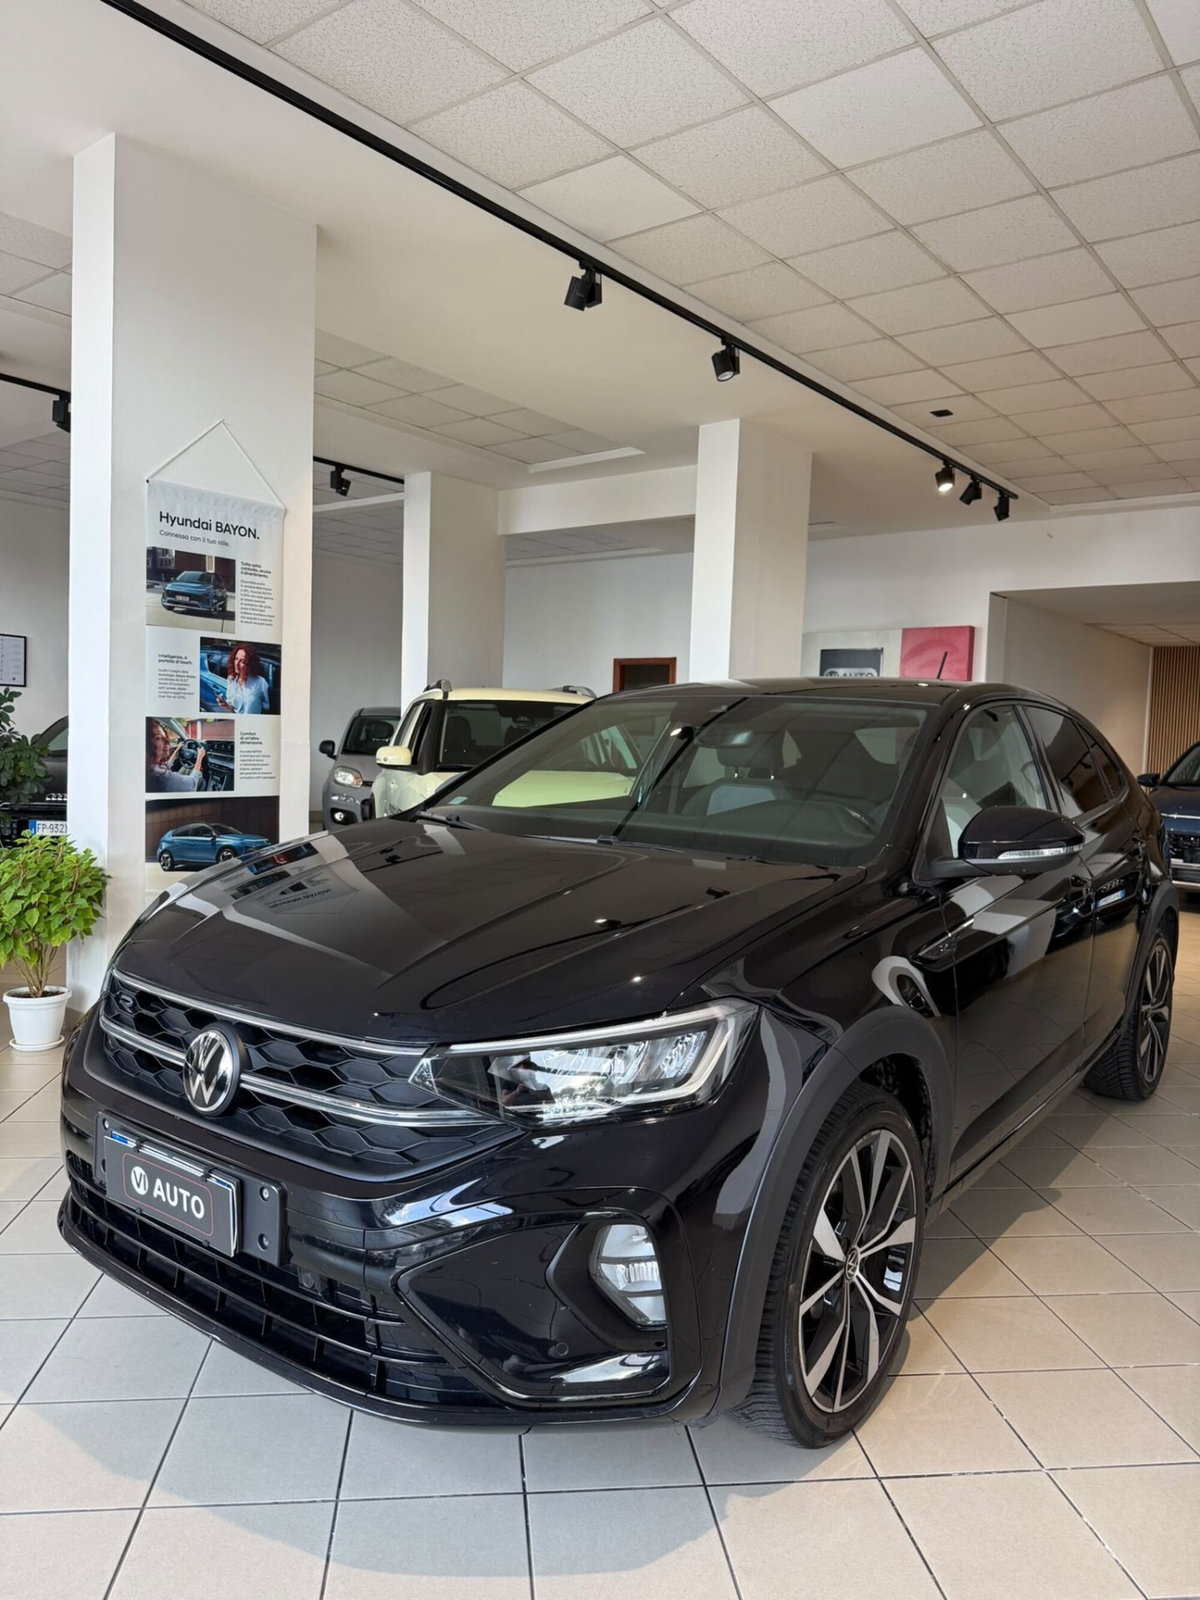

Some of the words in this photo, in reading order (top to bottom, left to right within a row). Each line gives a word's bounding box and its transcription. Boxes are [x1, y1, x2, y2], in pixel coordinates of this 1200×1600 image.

[159, 511, 212, 531] Hyundai
[215, 521, 260, 540] BAYON.
[159, 529, 189, 540] Connessa
[153, 1178, 205, 1219] AUTO
